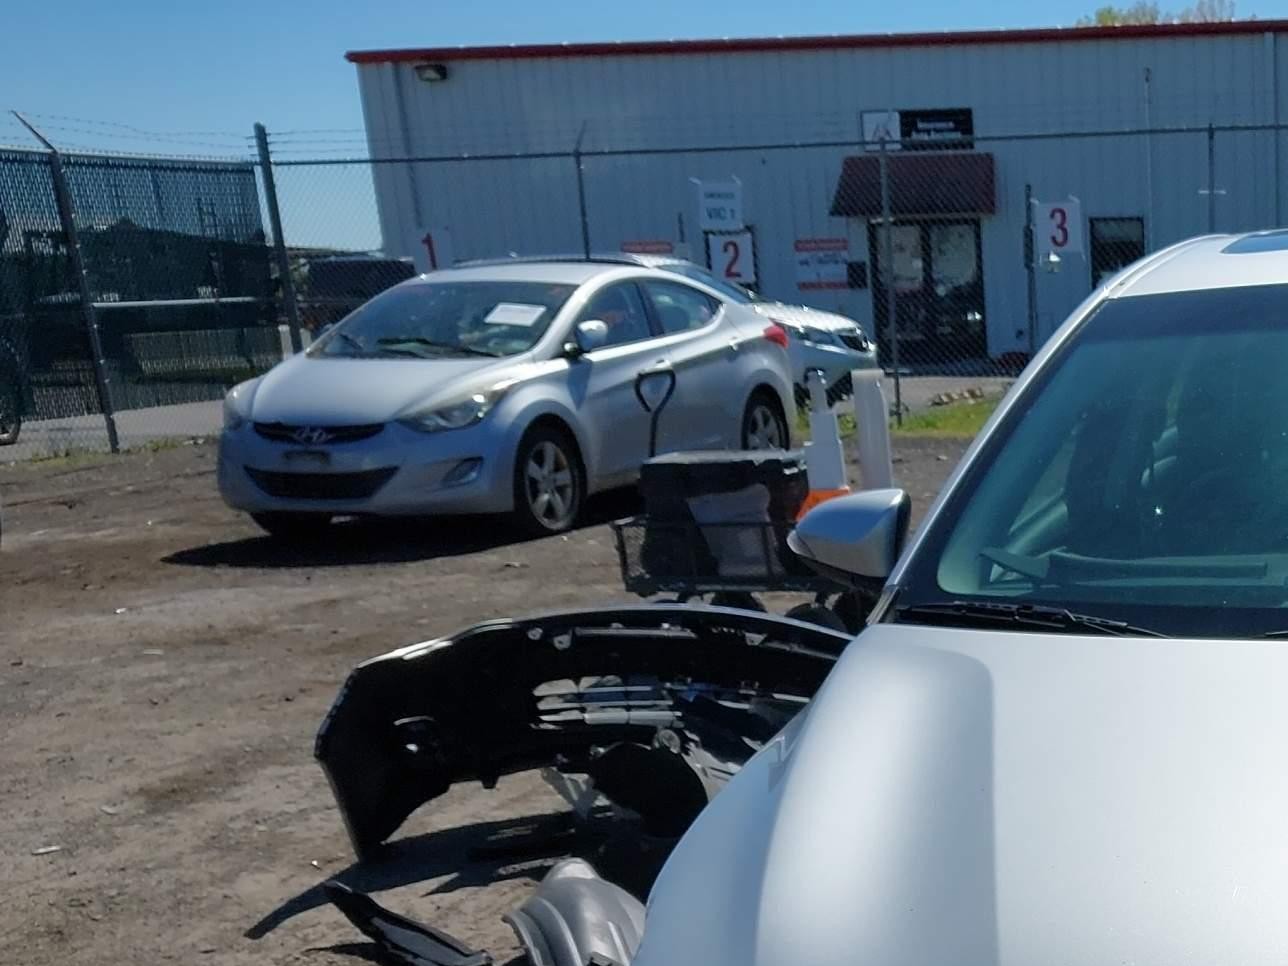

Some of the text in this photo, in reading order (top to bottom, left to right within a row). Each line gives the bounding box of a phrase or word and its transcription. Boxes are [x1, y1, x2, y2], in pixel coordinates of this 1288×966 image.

[1049, 207, 1068, 247] 3
[421, 232, 437, 270] 1
[722, 240, 741, 277] 2
